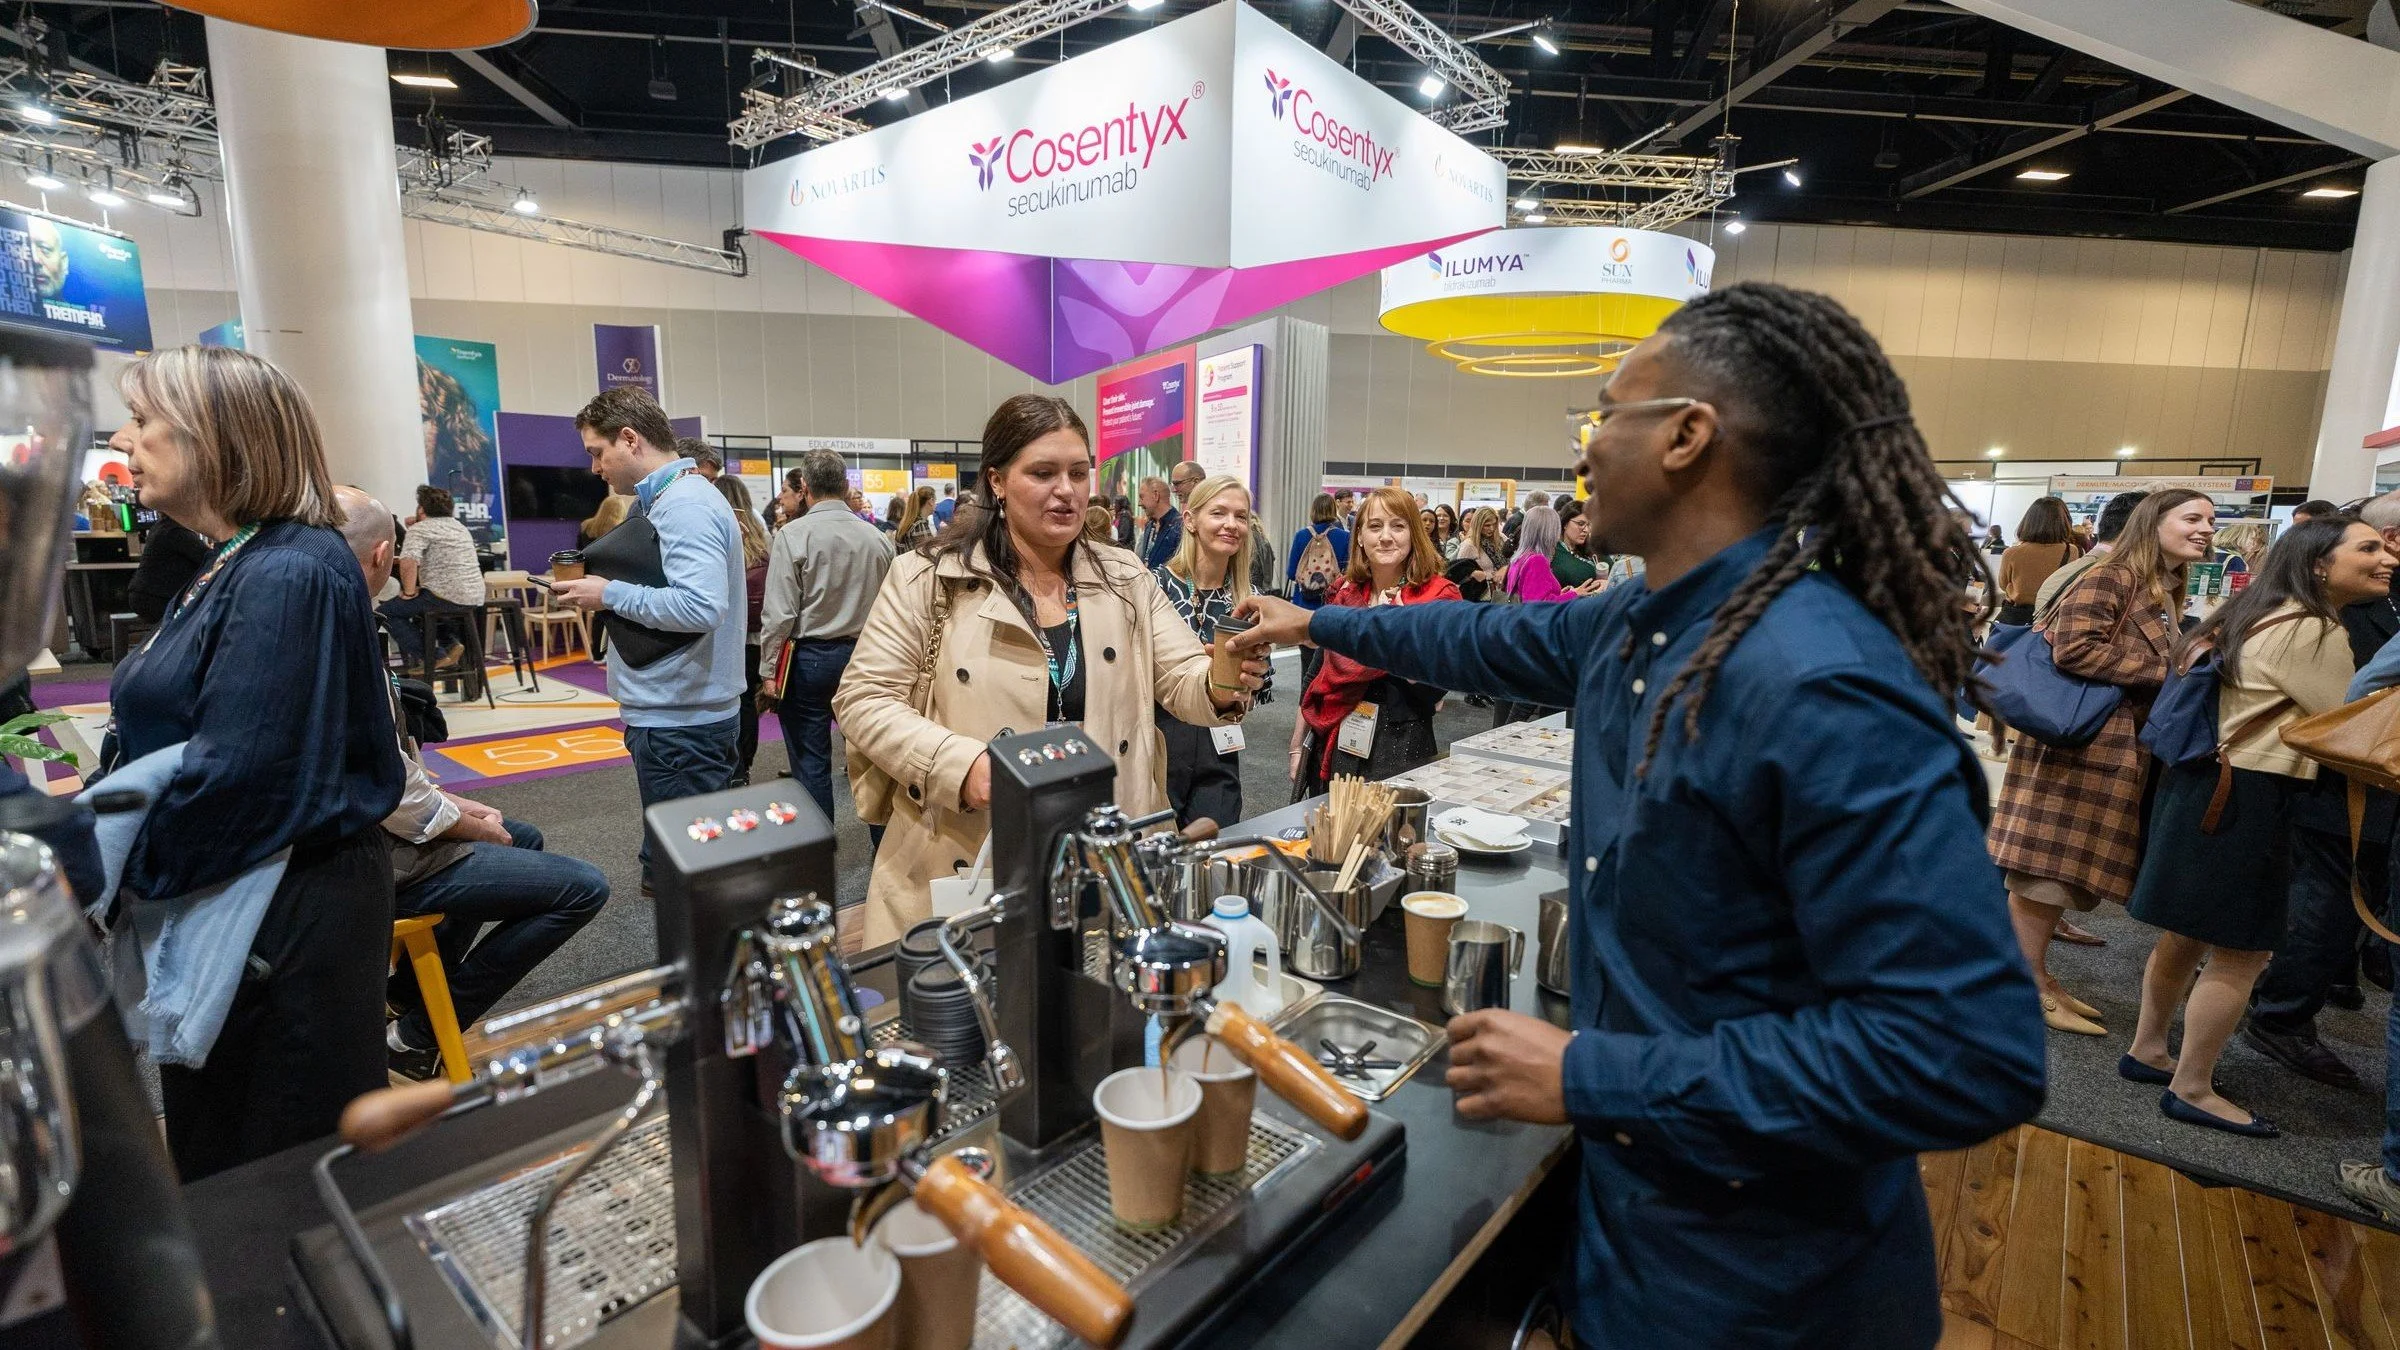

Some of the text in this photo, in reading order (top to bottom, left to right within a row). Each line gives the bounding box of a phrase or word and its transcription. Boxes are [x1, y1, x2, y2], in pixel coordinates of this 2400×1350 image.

[1294, 140, 1371, 191] secukinumab
[810, 164, 886, 203] NOVARTIS
[1008, 161, 1138, 217] secukinumab
[1448, 168, 1494, 203] NOVARTIS
[1602, 264, 1633, 277] SUN
[1695, 268, 1710, 289] ILU
[808, 439, 875, 450] EDUCATION HUB
[864, 473, 884, 489] 55
[2197, 481, 2232, 489] SYSTEMS
[483, 733, 626, 767] 55
